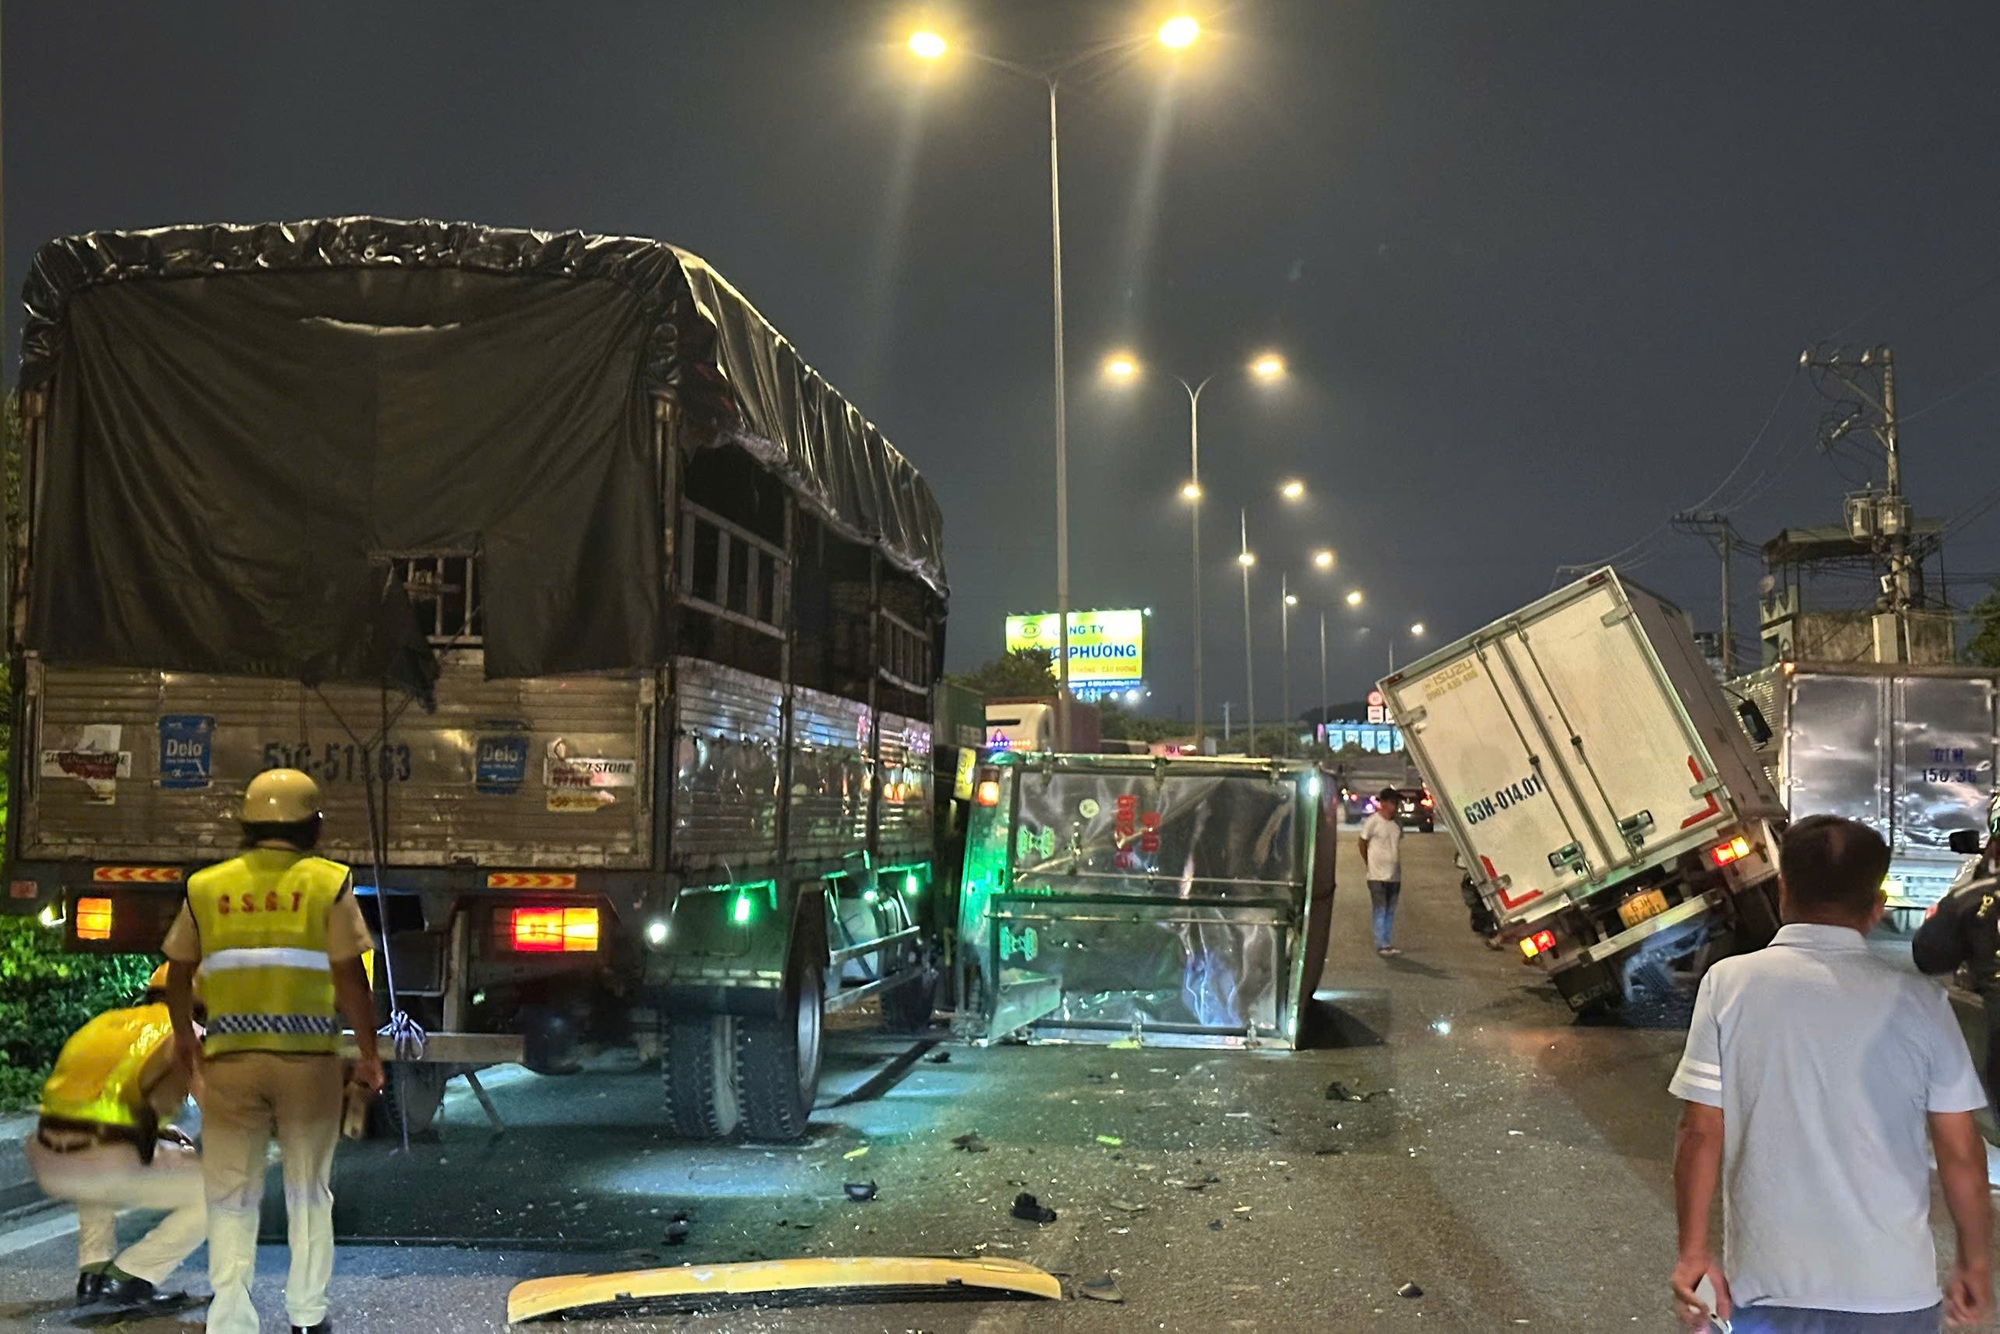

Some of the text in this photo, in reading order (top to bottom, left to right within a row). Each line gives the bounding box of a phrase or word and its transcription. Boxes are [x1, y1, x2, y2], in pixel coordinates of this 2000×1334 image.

[1091, 625, 1105, 633] TY
[166, 738, 203, 757] Delo
[482, 744, 518, 762] Delo
[1463, 774, 1543, 826] 63H-014.01
